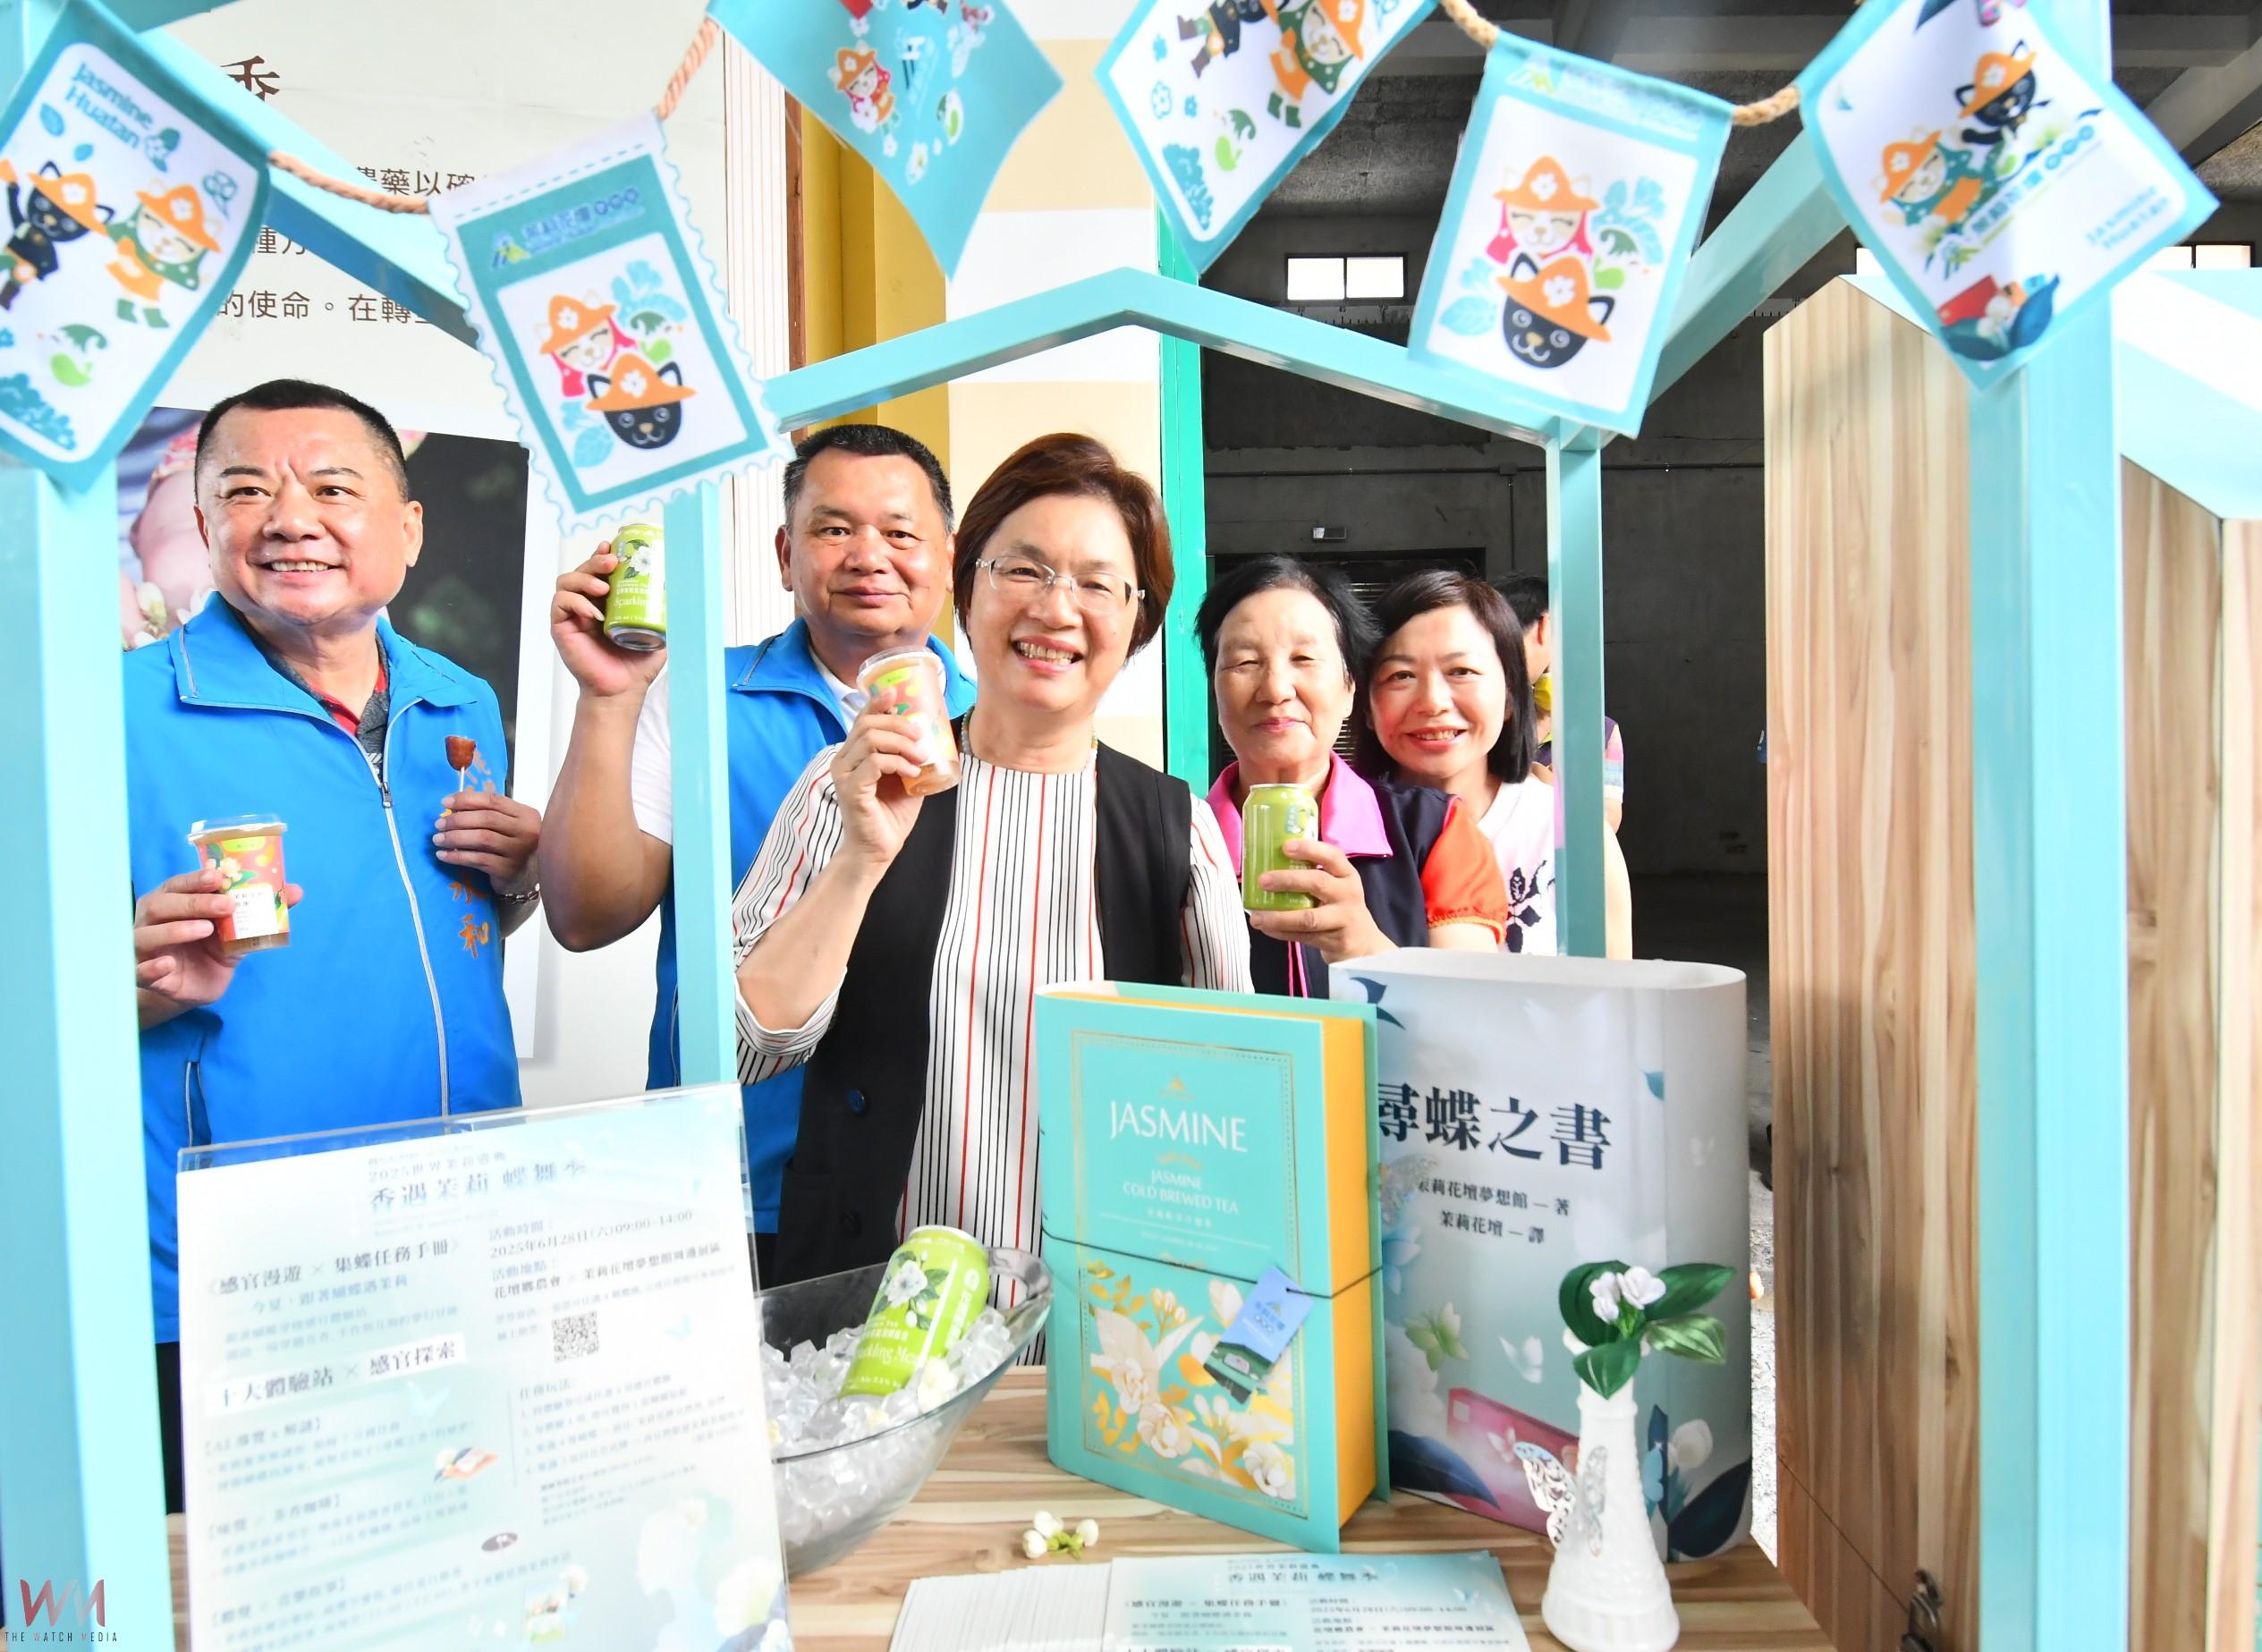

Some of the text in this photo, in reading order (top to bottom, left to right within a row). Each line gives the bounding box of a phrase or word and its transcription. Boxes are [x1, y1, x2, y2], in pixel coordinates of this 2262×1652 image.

[64, 85, 141, 149] Huatan
[72, 62, 154, 131] Jasmine
[217, 290, 430, 324] 的使命。在轉
[1110, 1099, 1249, 1153] JASMINE
[1378, 1082, 1613, 1170] 尋蝶之書
[1123, 1181, 1240, 1215] COLD BREWED TEA
[1151, 1168, 1203, 1190] JASMINE
[222, 1367, 335, 1408] 十大體驗站
[368, 1341, 457, 1377] 感官探索
